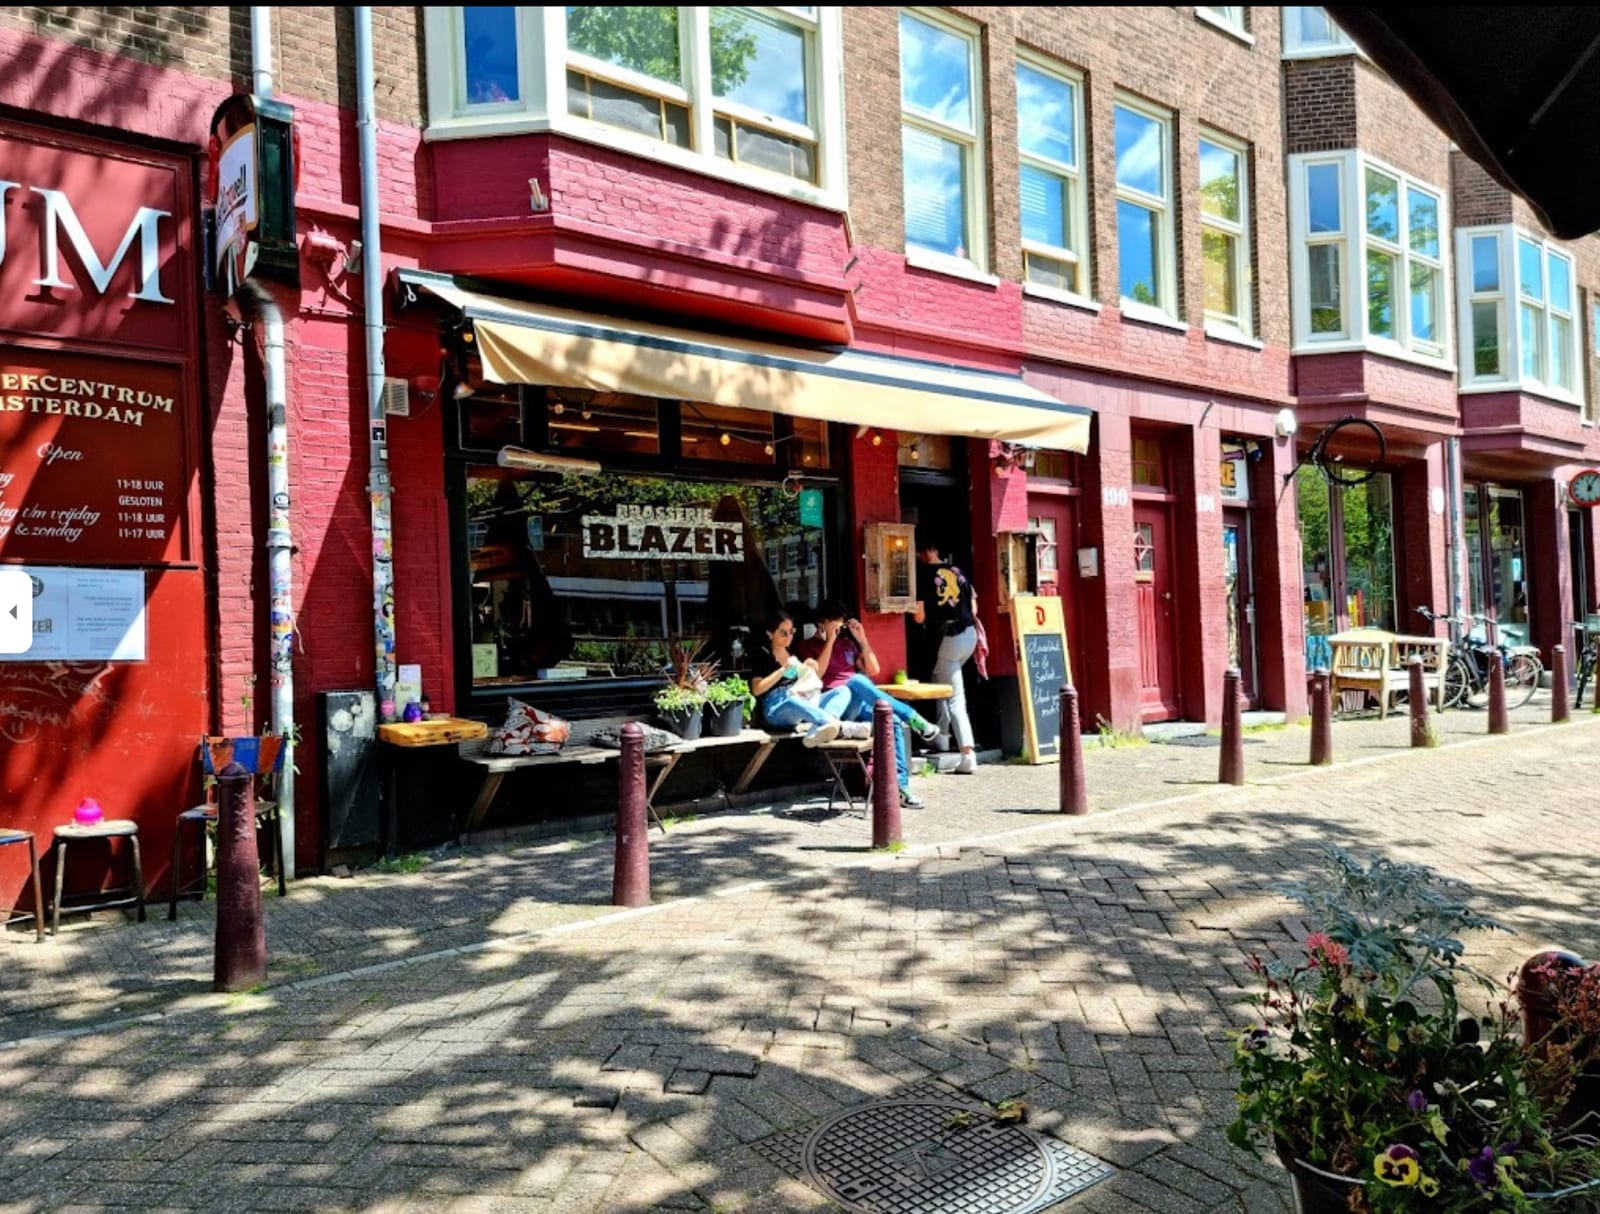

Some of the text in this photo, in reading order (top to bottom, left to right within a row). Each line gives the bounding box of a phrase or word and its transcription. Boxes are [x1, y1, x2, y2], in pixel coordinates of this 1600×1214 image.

[1, 372, 175, 413] EKCENTRUM
[36, 442, 84, 465] Open
[116, 479, 165, 491] 11-18 UUR
[118, 495, 163, 507] GESLOTEN
[117, 512, 166, 524] 11-18 UUR
[616, 503, 713, 523] BRASSERIE
[14, 521, 30, 536] &
[31, 523, 83, 543] zondag
[118, 528, 166, 539] 11-17 UUR
[588, 523, 741, 555] BLAZER
